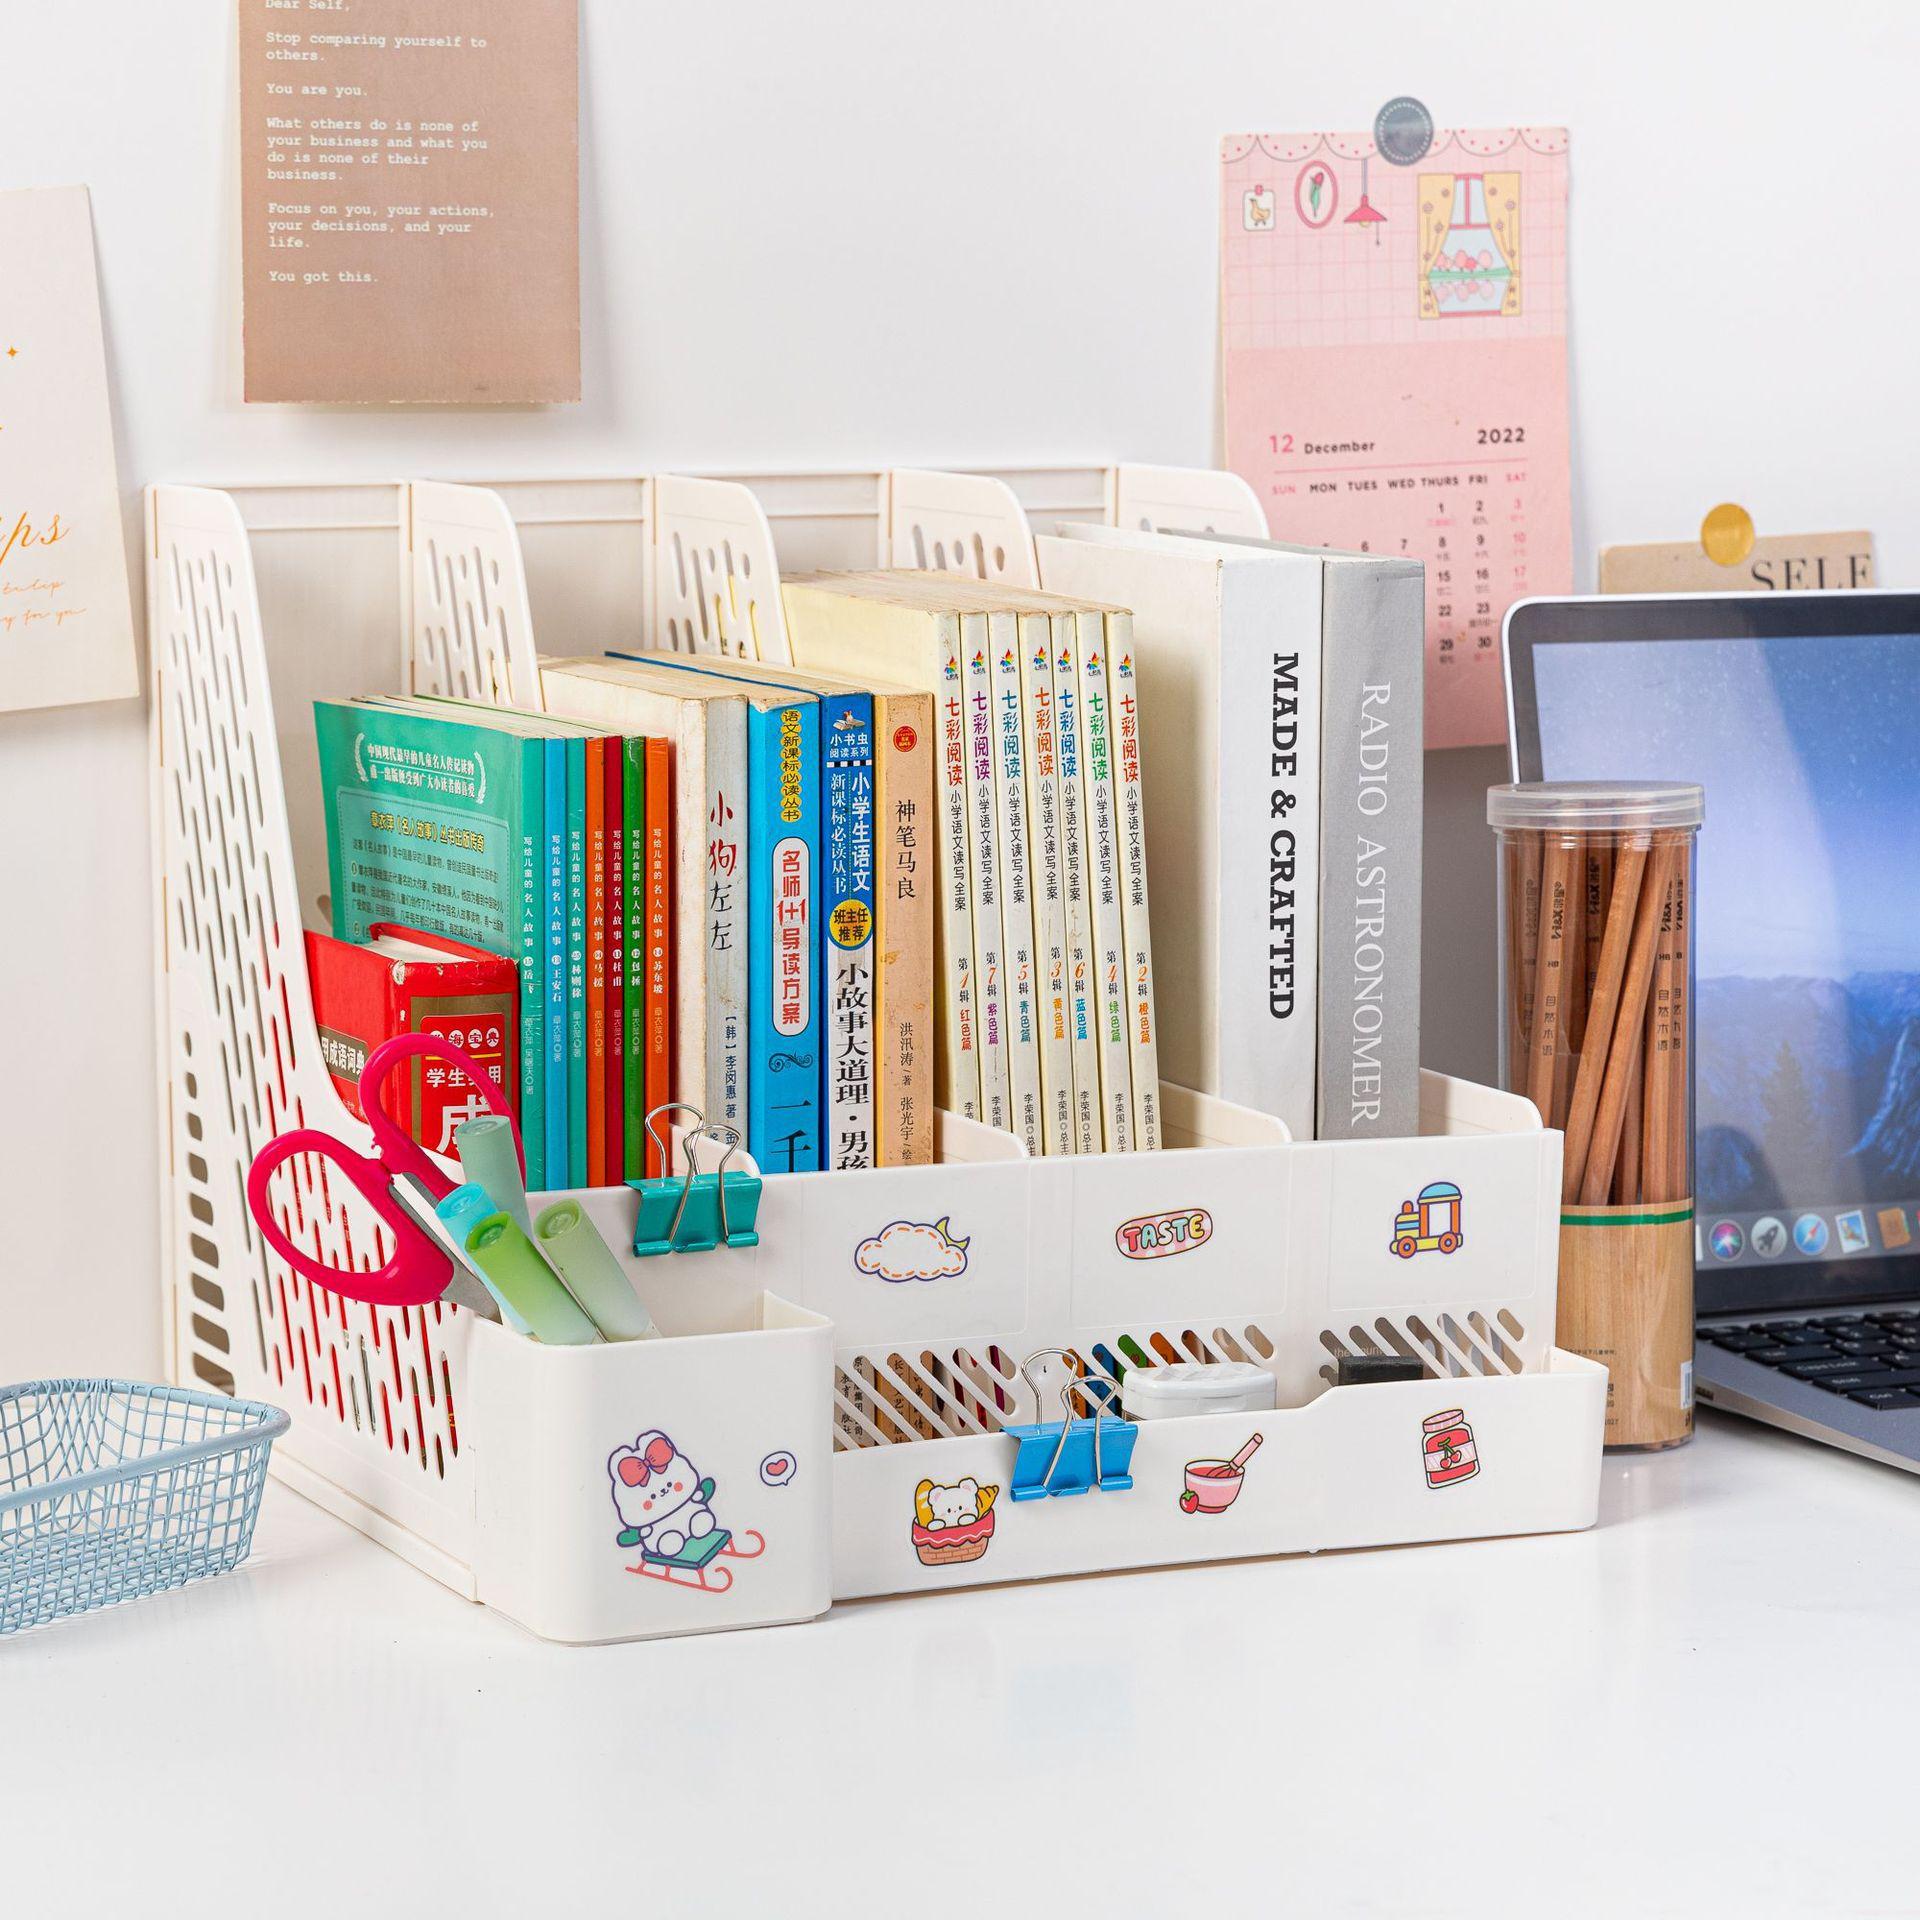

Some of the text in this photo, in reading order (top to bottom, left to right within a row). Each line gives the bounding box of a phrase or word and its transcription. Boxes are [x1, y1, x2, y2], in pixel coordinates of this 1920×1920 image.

[266, 32, 487, 49] Stop comparing yourself to
[266, 49, 326, 62] others.
[266, 83, 368, 98] You are you.
[267, 117, 479, 133] What others do is none of
[267, 134, 488, 152] your business and what you
[267, 151, 429, 165] do is none of their
[267, 168, 344, 180] business.
[267, 203, 495, 219] Focus on you, your actions,
[267, 220, 472, 235] your decisions, and your
[269, 237, 310, 249] life.
[269, 270, 378, 285] You got this.
[1268, 427, 1526, 454] 12 December 2022
[1272, 473, 1526, 495] SUN MON TUES WED THURS FRI SAT
[1438, 503, 1444, 514] 1
[1476, 500, 1484, 512] 2
[1400, 539, 1408, 550] 7
[1438, 536, 1446, 548] 8
[1476, 535, 1484, 546] 9
[1513, 532, 1526, 543] 10
[1438, 566, 1526, 582] 15 16 17
[1438, 603, 1490, 617] 22 23
[1477, 636, 1492, 649] 30
[829, 746, 870, 759] 阅读系列
[830, 733, 869, 747] 小书虫
[945, 696, 963, 787] 七彩阅读
[972, 690, 990, 781] 七彩阅读
[1002, 689, 1020, 779] 七彩阅读
[1035, 686, 1053, 777] 七彩阅读
[1059, 688, 1077, 779] 七彩阅读
[1089, 692, 1108, 782] 七彩阅读
[1120, 694, 1139, 783] 七彩阅读
[782, 710, 800, 822] 语文新课标必读丛书
[830, 773, 847, 895] 新课标必读丛书
[851, 771, 871, 893] 小学生语文
[895, 799, 917, 900] 神笔马良
[950, 790, 966, 911] 小学语文读写全案
[978, 784, 993, 905] 小学语文读写全案
[1008, 783, 1025, 903] 小学语文读写全案
[1041, 780, 1058, 901] 小学语文读写全案
[1064, 781, 1081, 902] 小学语文读写全案
[1096, 784, 1113, 905] 小学语文读写全案
[1126, 786, 1144, 907] 小学语文读写全案
[1269, 652, 1299, 1020] MADE & CRAFTED
[523, 836, 534, 948] 写给儿童的名人故事
[571, 831, 581, 941] 写给儿童的名人故事
[593, 831, 603, 941] 写给儿童的名人故事
[612, 830, 622, 940] 写给儿童的名人故事
[632, 829, 641, 940] 写给儿童的名人故事
[709, 790, 737, 951] 小狗左左
[551, 834, 562, 1003] 写给儿童的名人故事 王安石
[652, 828, 663, 994] 写给儿童的名人故事 苏东坡
[833, 908, 869, 925] 班主任
[1351, 680, 1391, 1128] RADIO ASTRONOMER
[777, 850, 806, 1025] 名师1+1导读方案
[838, 925, 865, 942] 推荐
[957, 957, 970, 1003] 第1辑
[985, 952, 997, 997] 第7辑
[1016, 950, 1029, 995] 第5辑
[1050, 947, 1062, 992] 第3辑
[1073, 948, 1085, 993] 第6辑
[1106, 950, 1118, 995] 第4辑
[1135, 952, 1148, 997] 第2辑
[431, 1028, 499, 1048] 海宝典
[959, 1008, 972, 1050] 红色篇
[987, 1002, 999, 1045] 紫色篇
[1019, 1000, 1031, 1043] 青色篇
[1052, 997, 1065, 1040] 黄色篇
[1075, 998, 1088, 1041] 蓝色篇
[1108, 1000, 1121, 1043] 绿色篇
[1138, 1002, 1151, 1045] 橙色篇
[427, 1065, 501, 1088] 学生用
[1122, 1212, 1206, 1255] TASTE
